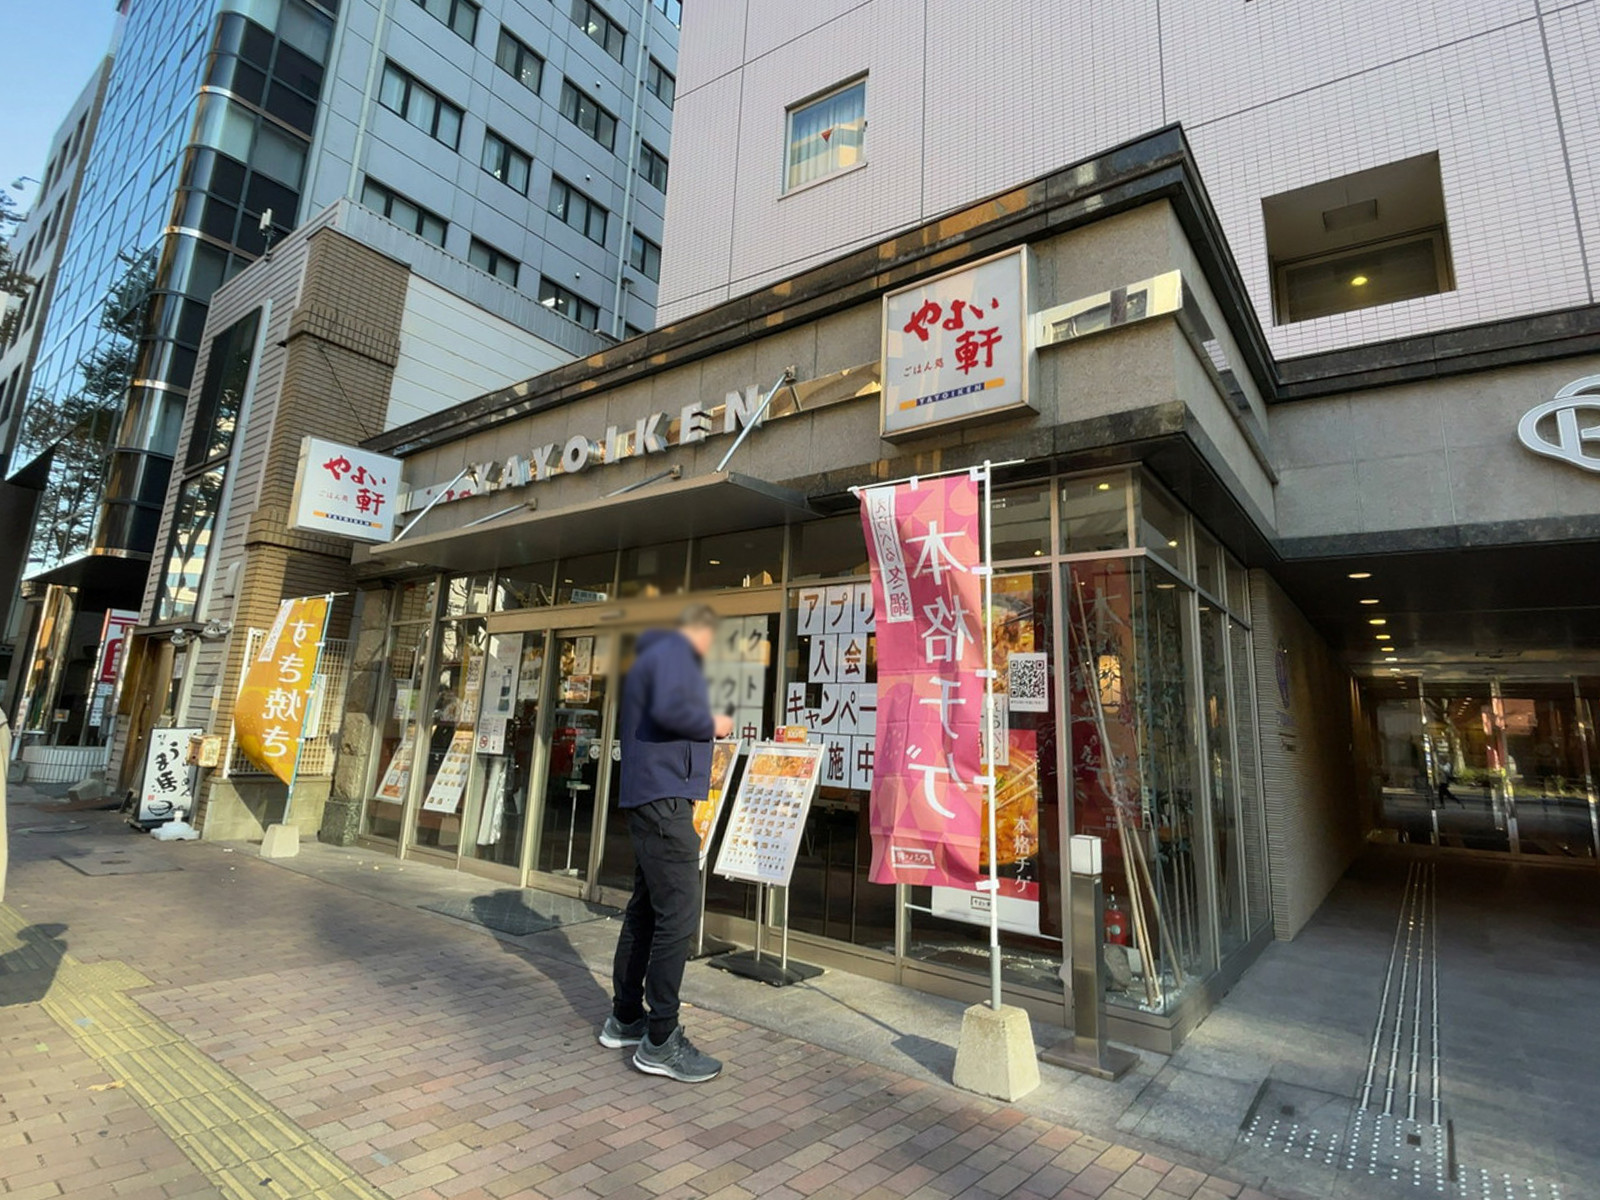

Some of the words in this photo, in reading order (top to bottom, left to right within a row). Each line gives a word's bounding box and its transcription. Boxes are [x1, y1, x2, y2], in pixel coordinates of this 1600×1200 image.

[903, 297, 1000, 342] やよい
[903, 357, 945, 378] ごはん処
[955, 326, 1003, 375] 軒
[919, 383, 983, 406] YAYOIKEN
[474, 384, 766, 496] YAYOIKEN
[322, 454, 387, 486] やよい
[356, 487, 386, 516] 軒
[803, 591, 876, 629] アプリ
[813, 637, 862, 676] 入会
[1013, 815, 1032, 893] 本格チゲ
